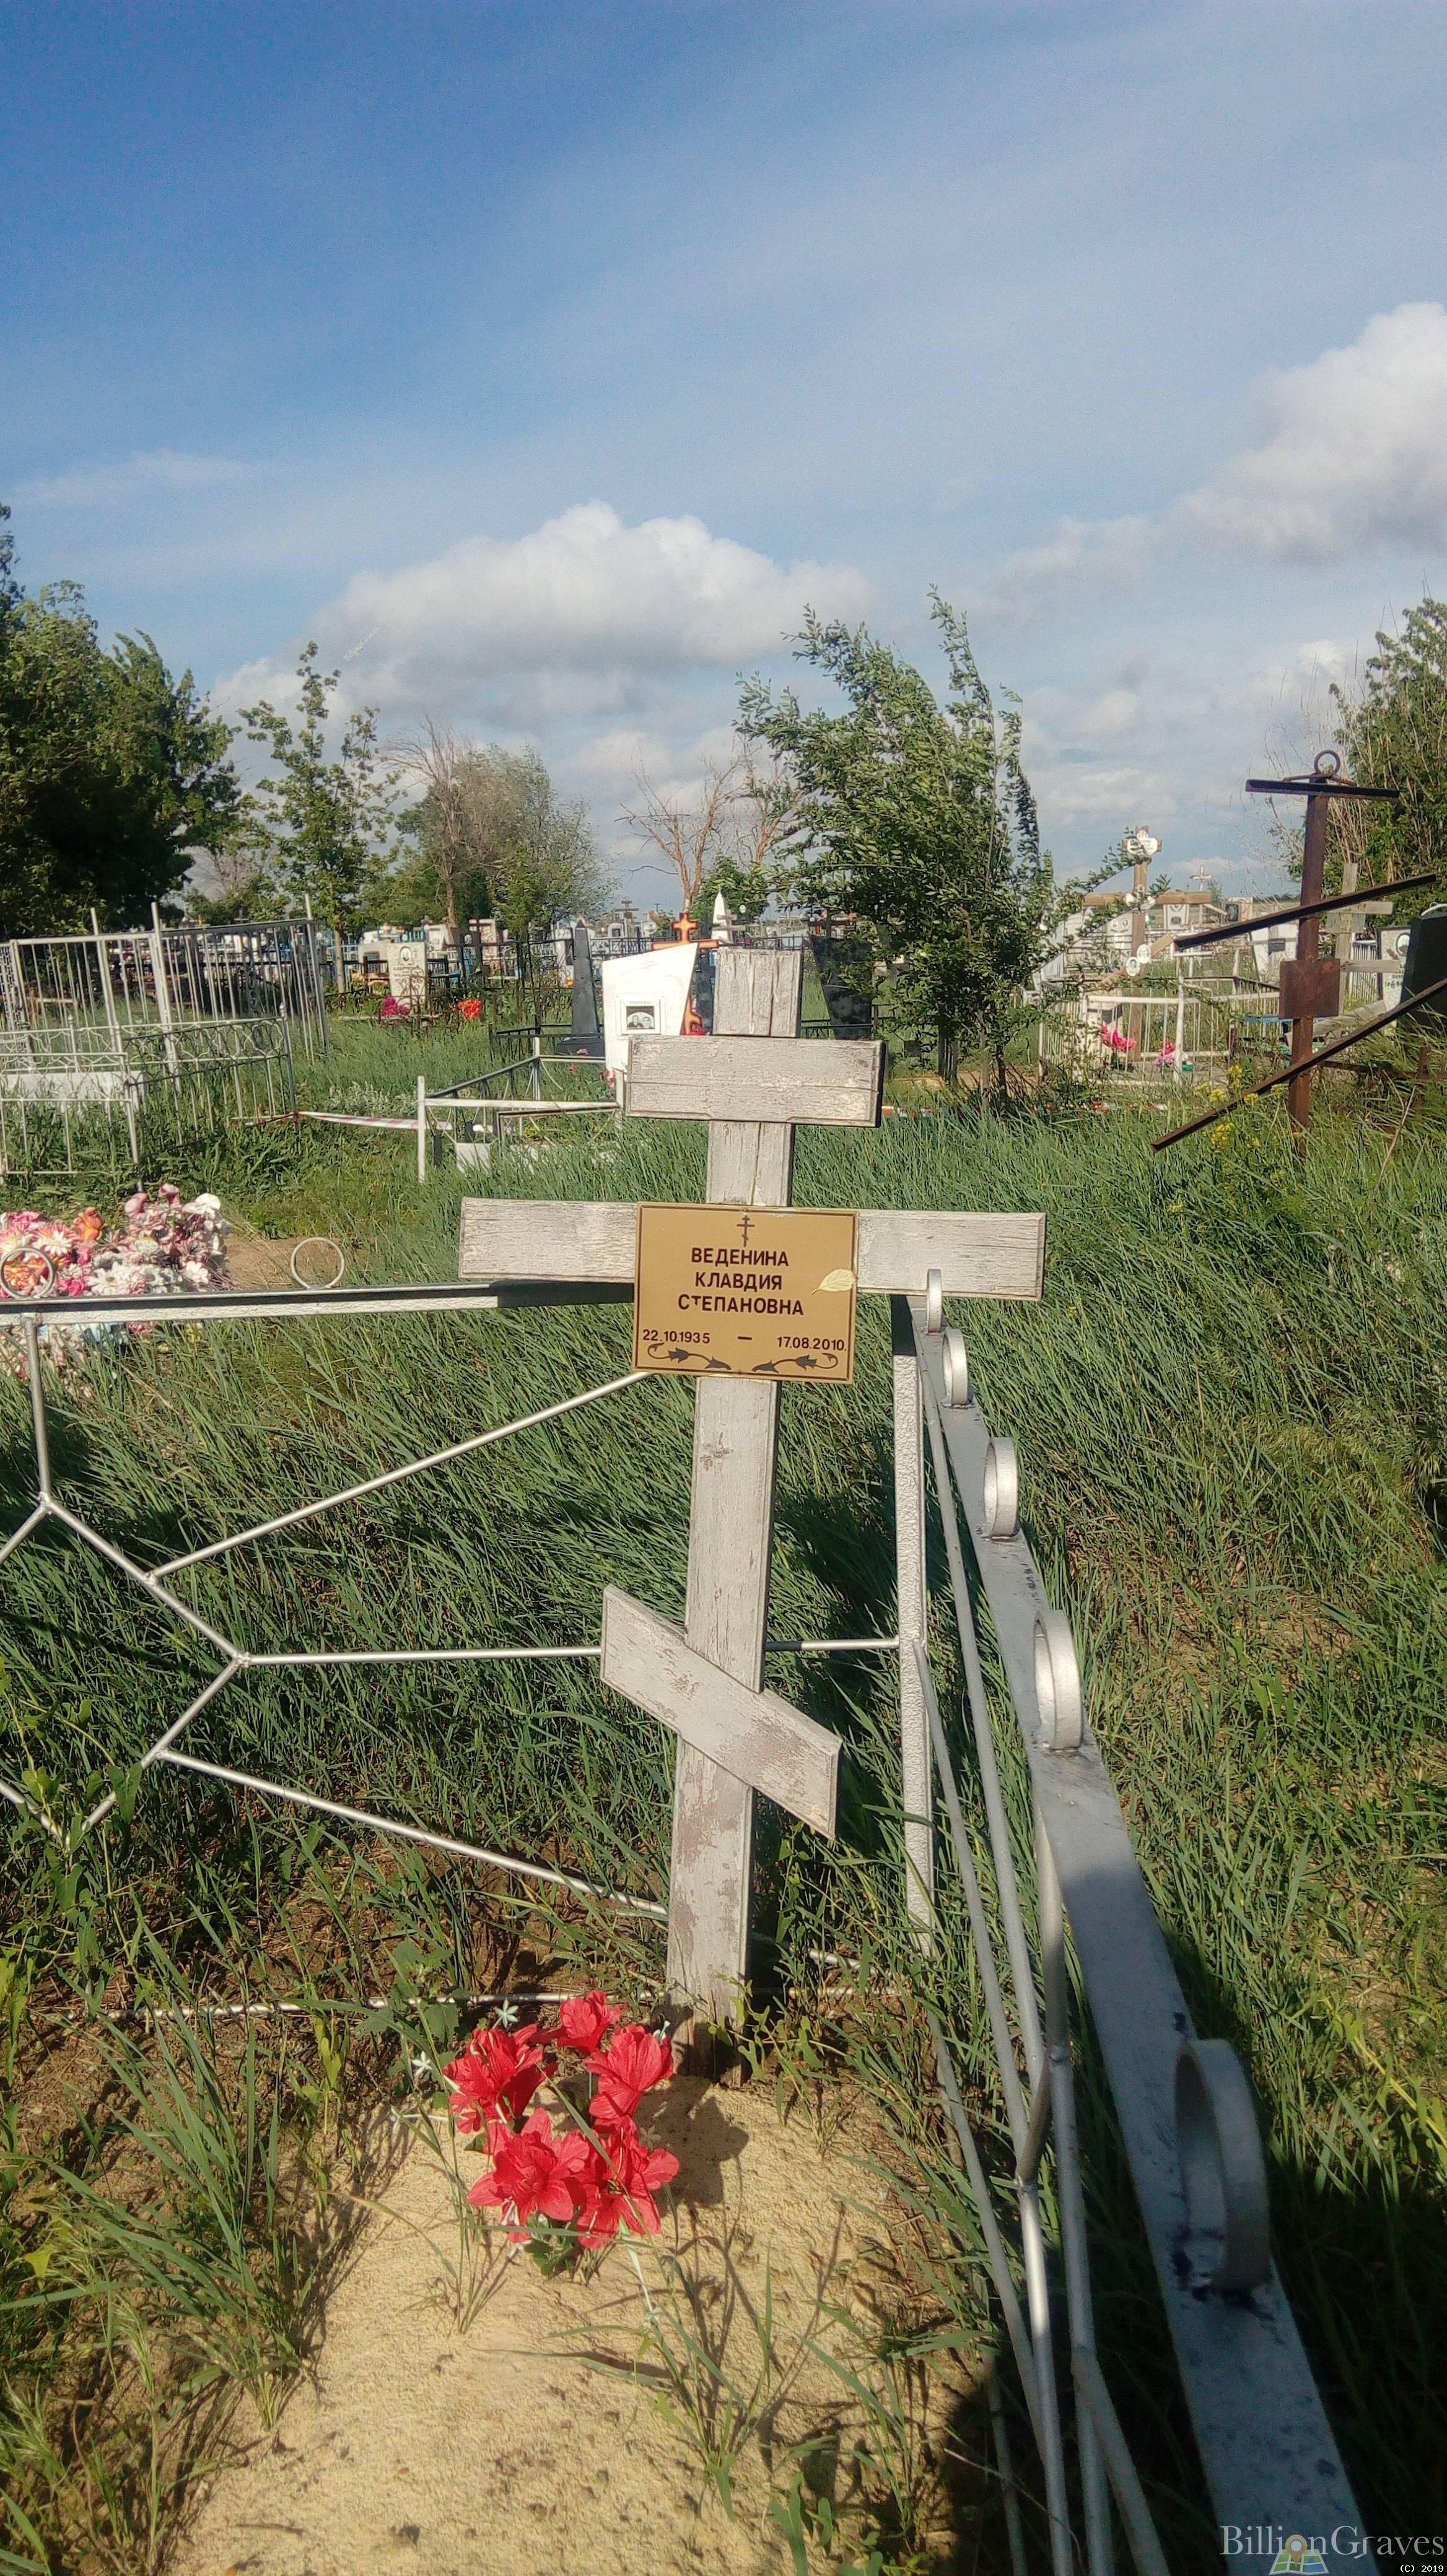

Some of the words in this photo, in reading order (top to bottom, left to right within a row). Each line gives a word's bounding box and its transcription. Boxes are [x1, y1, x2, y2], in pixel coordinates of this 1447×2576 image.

[691, 1247, 789, 1267] ВЕДЕНИНА
[695, 1272, 782, 1292] КЛАВДИЯ
[678, 1294, 803, 1315] СТЕПАНОВНА
[642, 1329, 710, 1344] 22.10.1935
